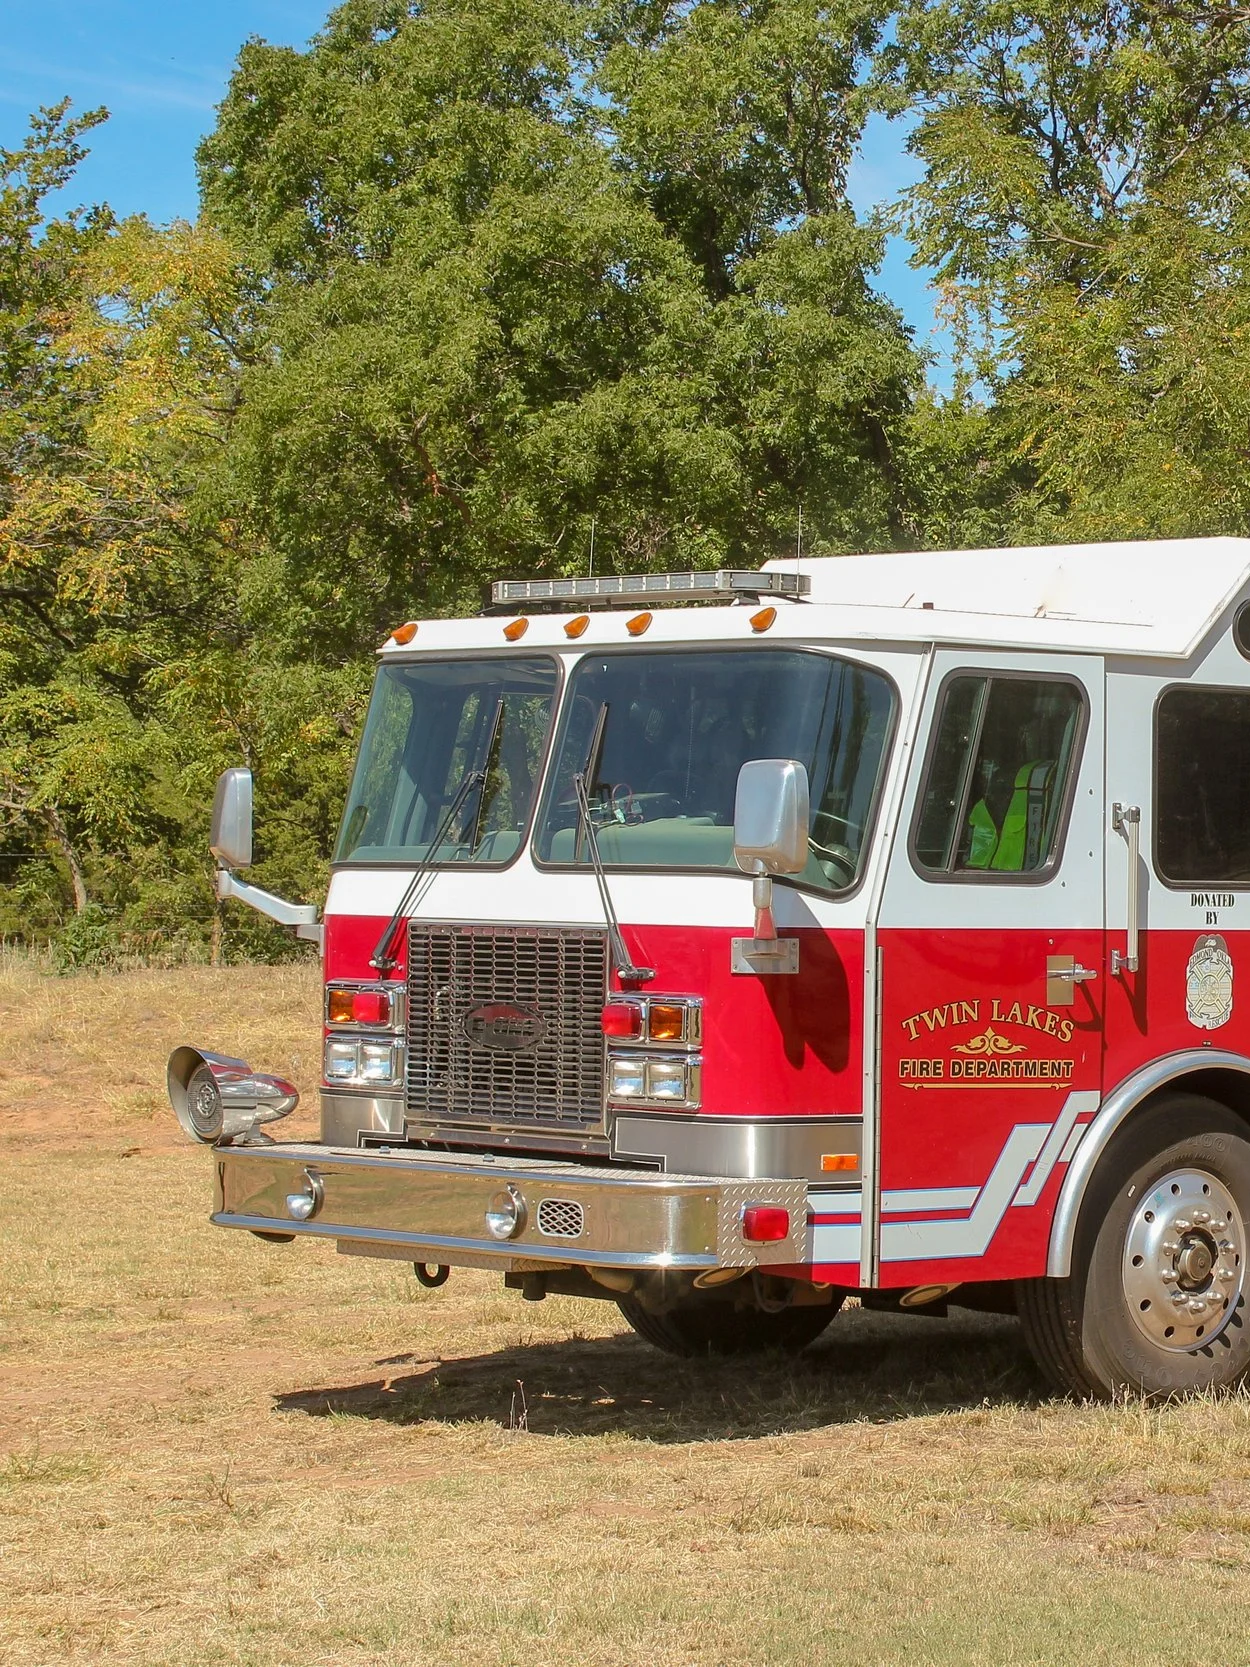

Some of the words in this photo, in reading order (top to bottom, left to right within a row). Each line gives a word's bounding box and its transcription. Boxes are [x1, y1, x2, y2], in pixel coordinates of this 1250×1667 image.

[1190, 893, 1235, 907] DONATED
[1206, 911, 1219, 925] BY
[1190, 947, 1213, 966] EDMOND
[902, 999, 980, 1041] TWIN
[991, 999, 1075, 1043] LAKES
[899, 1058, 944, 1078] FIRE
[950, 1058, 1075, 1078] DEPARTMENT
